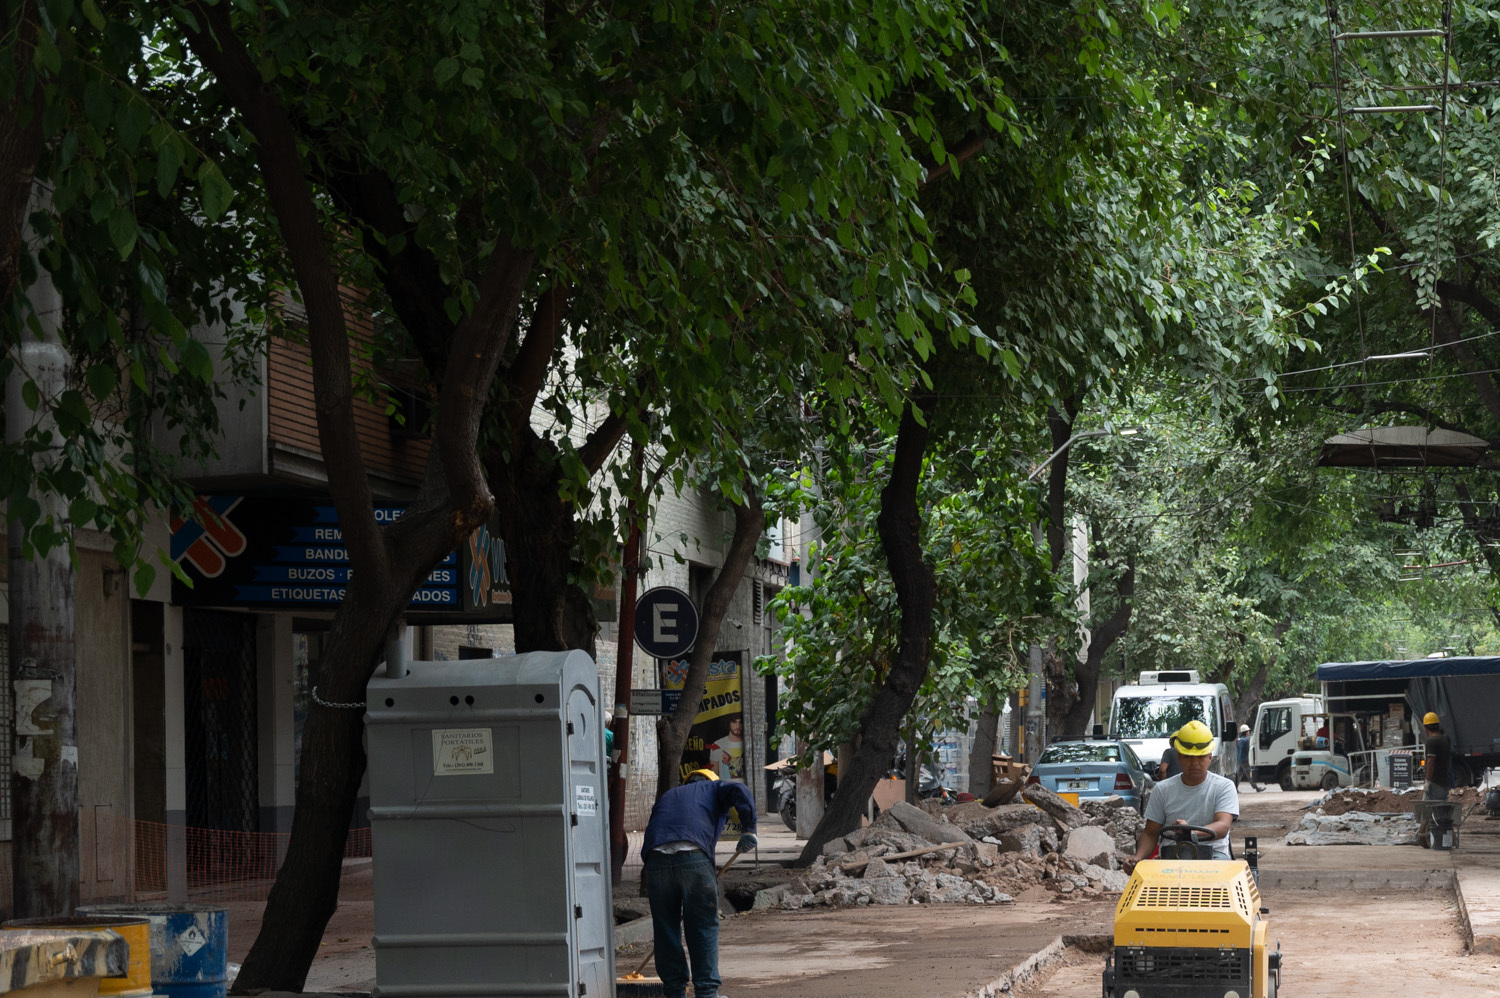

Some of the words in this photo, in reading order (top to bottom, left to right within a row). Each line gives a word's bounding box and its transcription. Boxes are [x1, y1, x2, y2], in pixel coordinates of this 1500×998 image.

[288, 568, 335, 580] BUZOS
[271, 588, 346, 600] ETIQUETAS
[653, 603, 679, 643] E
